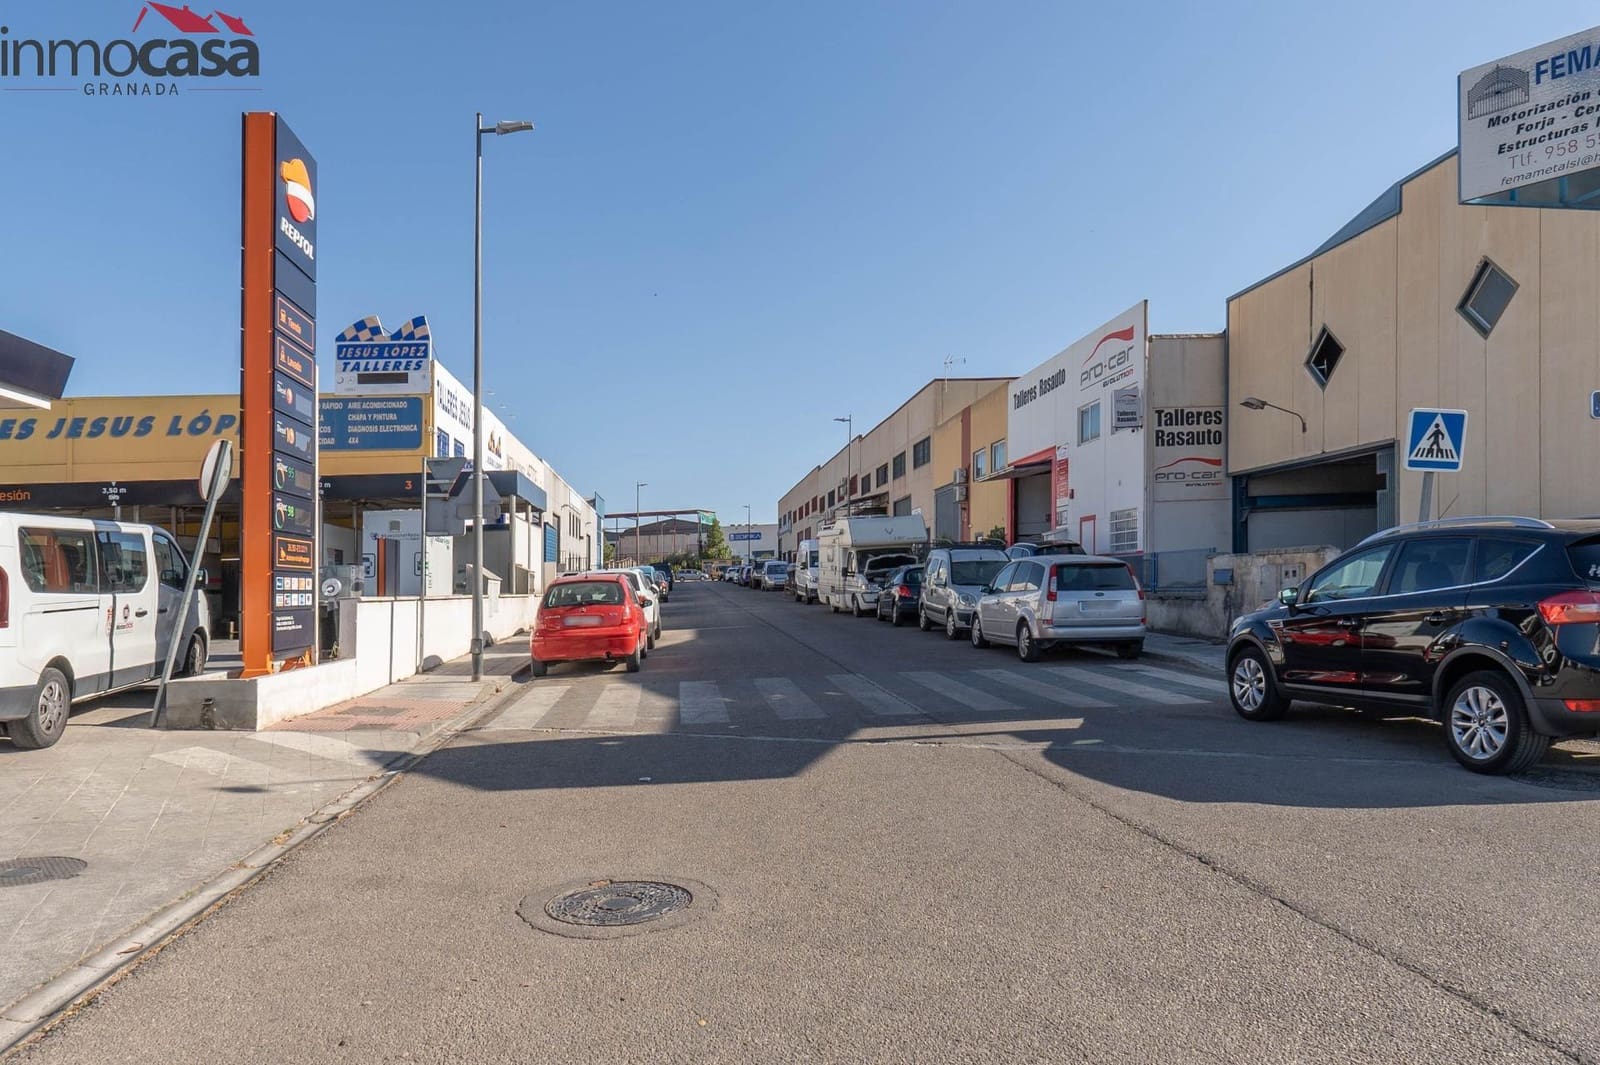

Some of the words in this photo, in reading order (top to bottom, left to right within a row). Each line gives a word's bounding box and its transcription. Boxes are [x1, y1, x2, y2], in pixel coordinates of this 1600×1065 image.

[1487, 89, 1591, 129] Motorización
[1516, 115, 1555, 135] Forja
[1498, 122, 1589, 155] Estructuras
[1509, 150, 1537, 170] Tlf.
[1545, 139, 1578, 159] 958
[281, 216, 314, 260] REPSOL
[342, 360, 423, 372] TALLERES
[1014, 385, 1037, 410] Talleres
[1039, 368, 1066, 397] Rasauto
[362, 401, 408, 409] ACONDICIONADO
[348, 413, 367, 421] CHAPA
[368, 413, 373, 421] Y
[373, 413, 398, 421] PINTURA
[1155, 409, 1222, 427] Talleres
[46, 415, 156, 439] JESUS
[348, 425, 379, 433] DIAGNOSIS
[1155, 429, 1222, 447] Rasauto
[405, 481, 412, 490] 3
